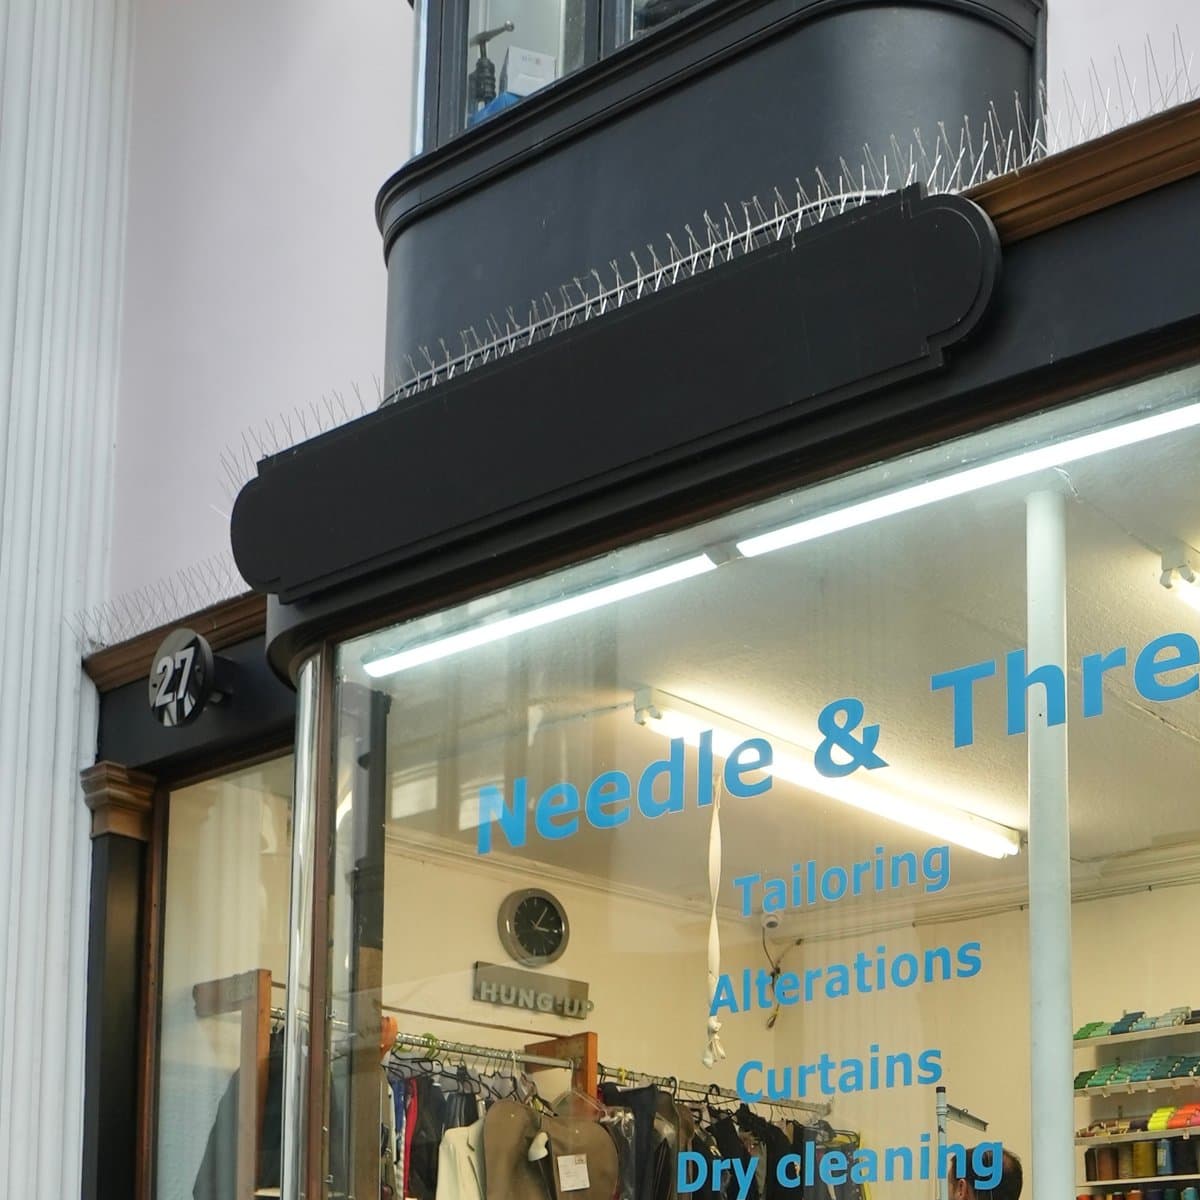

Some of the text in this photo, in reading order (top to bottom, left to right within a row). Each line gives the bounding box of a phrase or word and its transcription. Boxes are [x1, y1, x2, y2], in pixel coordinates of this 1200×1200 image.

[155, 646, 195, 708] 27
[477, 730, 771, 853] Needle
[815, 698, 888, 774] &
[735, 847, 951, 916] Tailoring
[708, 941, 982, 1016] Alterations
[735, 1045, 944, 1104] Curtains
[776, 1135, 1003, 1191] cleaning
